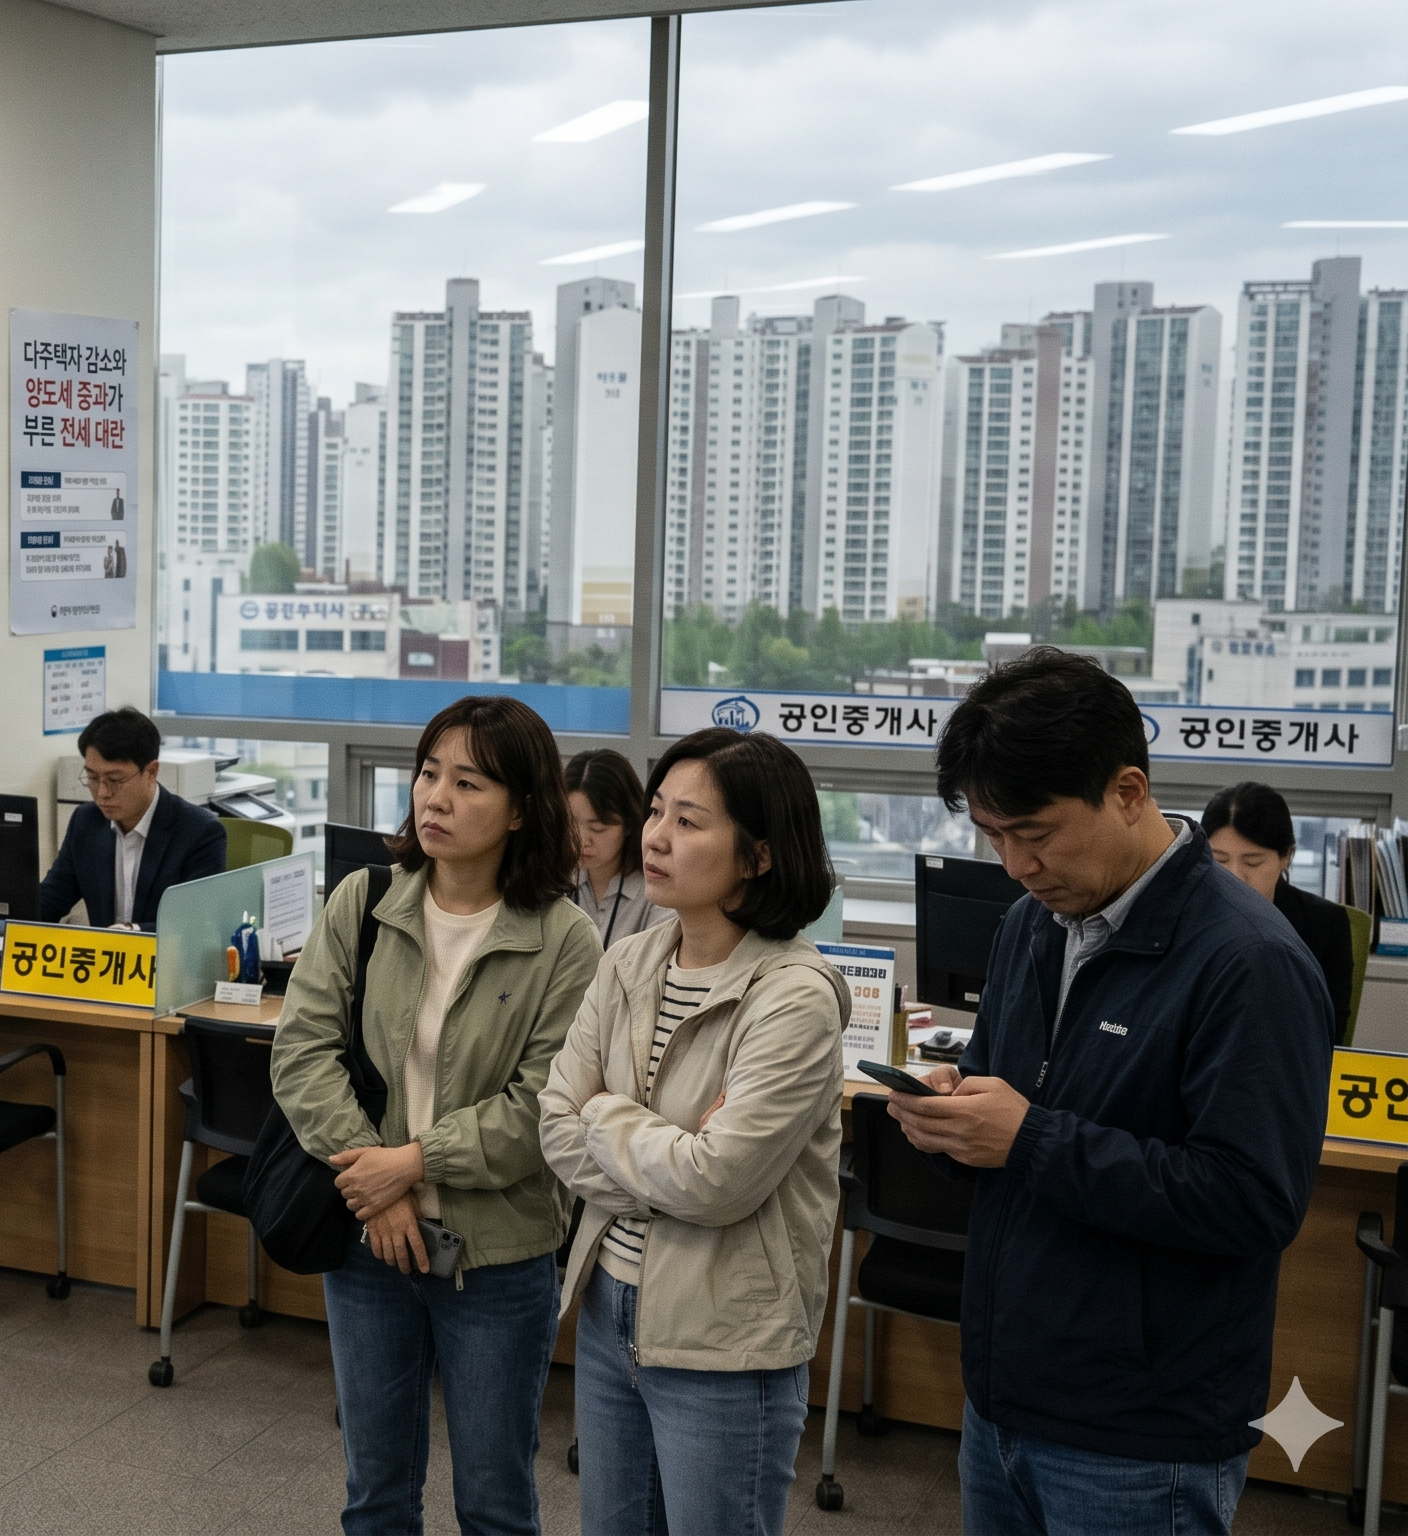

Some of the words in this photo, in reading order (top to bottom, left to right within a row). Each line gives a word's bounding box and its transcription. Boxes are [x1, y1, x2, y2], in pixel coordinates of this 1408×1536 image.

[24, 340, 82, 372] 다주택자
[85, 345, 126, 376] 감소와
[26, 377, 72, 409] 양도세
[77, 381, 123, 412] 중과가
[23, 415, 55, 447] 부른
[60, 417, 90, 448] 전세
[95, 418, 125, 449] 대란
[779, 702, 937, 736] 공인중개사
[1180, 717, 1359, 754] 공인중개사
[12, 941, 156, 988] 공인중개사
